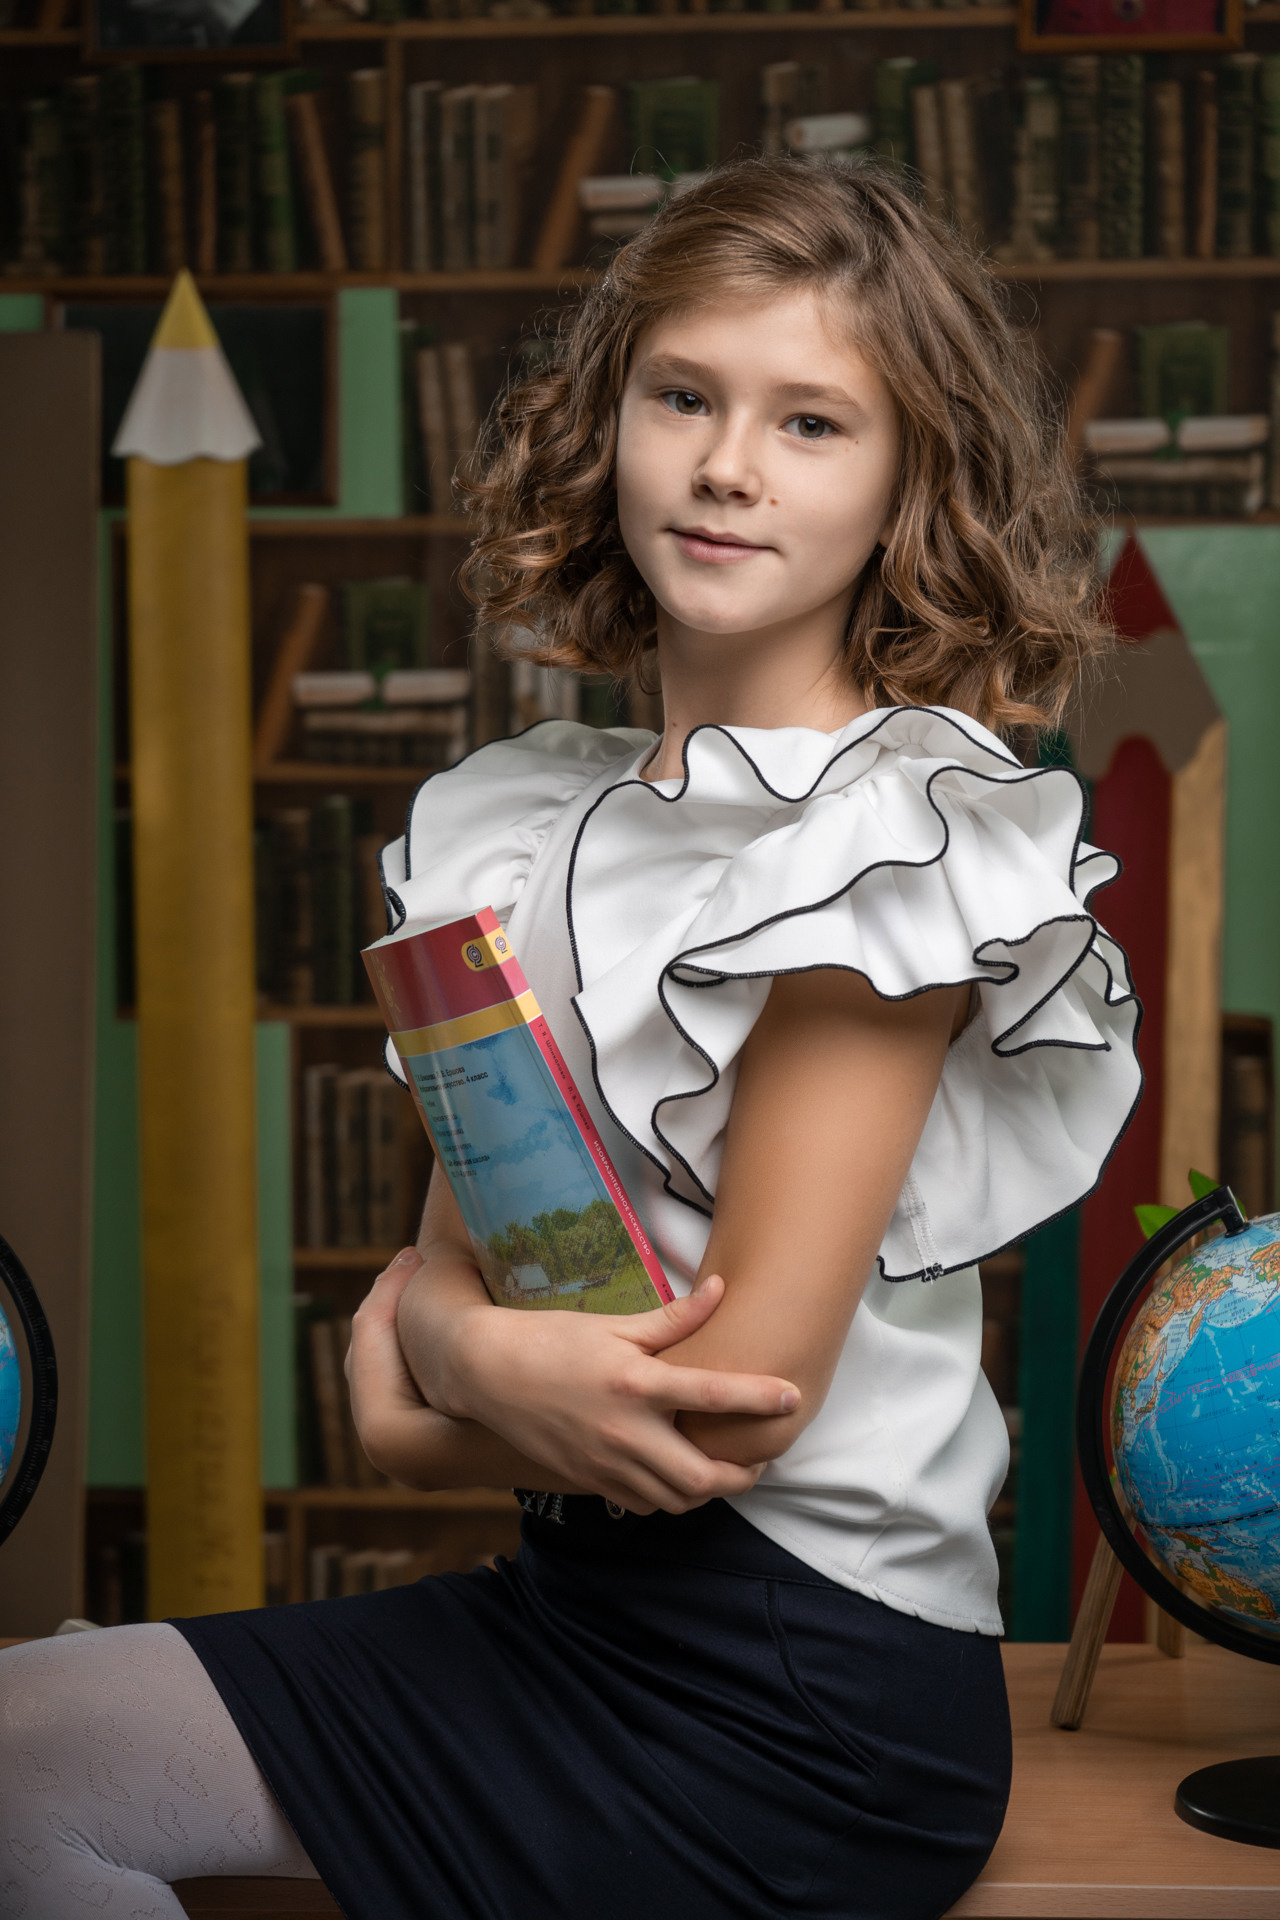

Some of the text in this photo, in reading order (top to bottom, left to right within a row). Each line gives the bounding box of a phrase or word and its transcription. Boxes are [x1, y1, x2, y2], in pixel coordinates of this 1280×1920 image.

[471, 1071, 489, 1082] класс
[592, 1140, 651, 1255] ИЗОБРАЗИТЕЛЬНОЕ ИСКУССТВО
